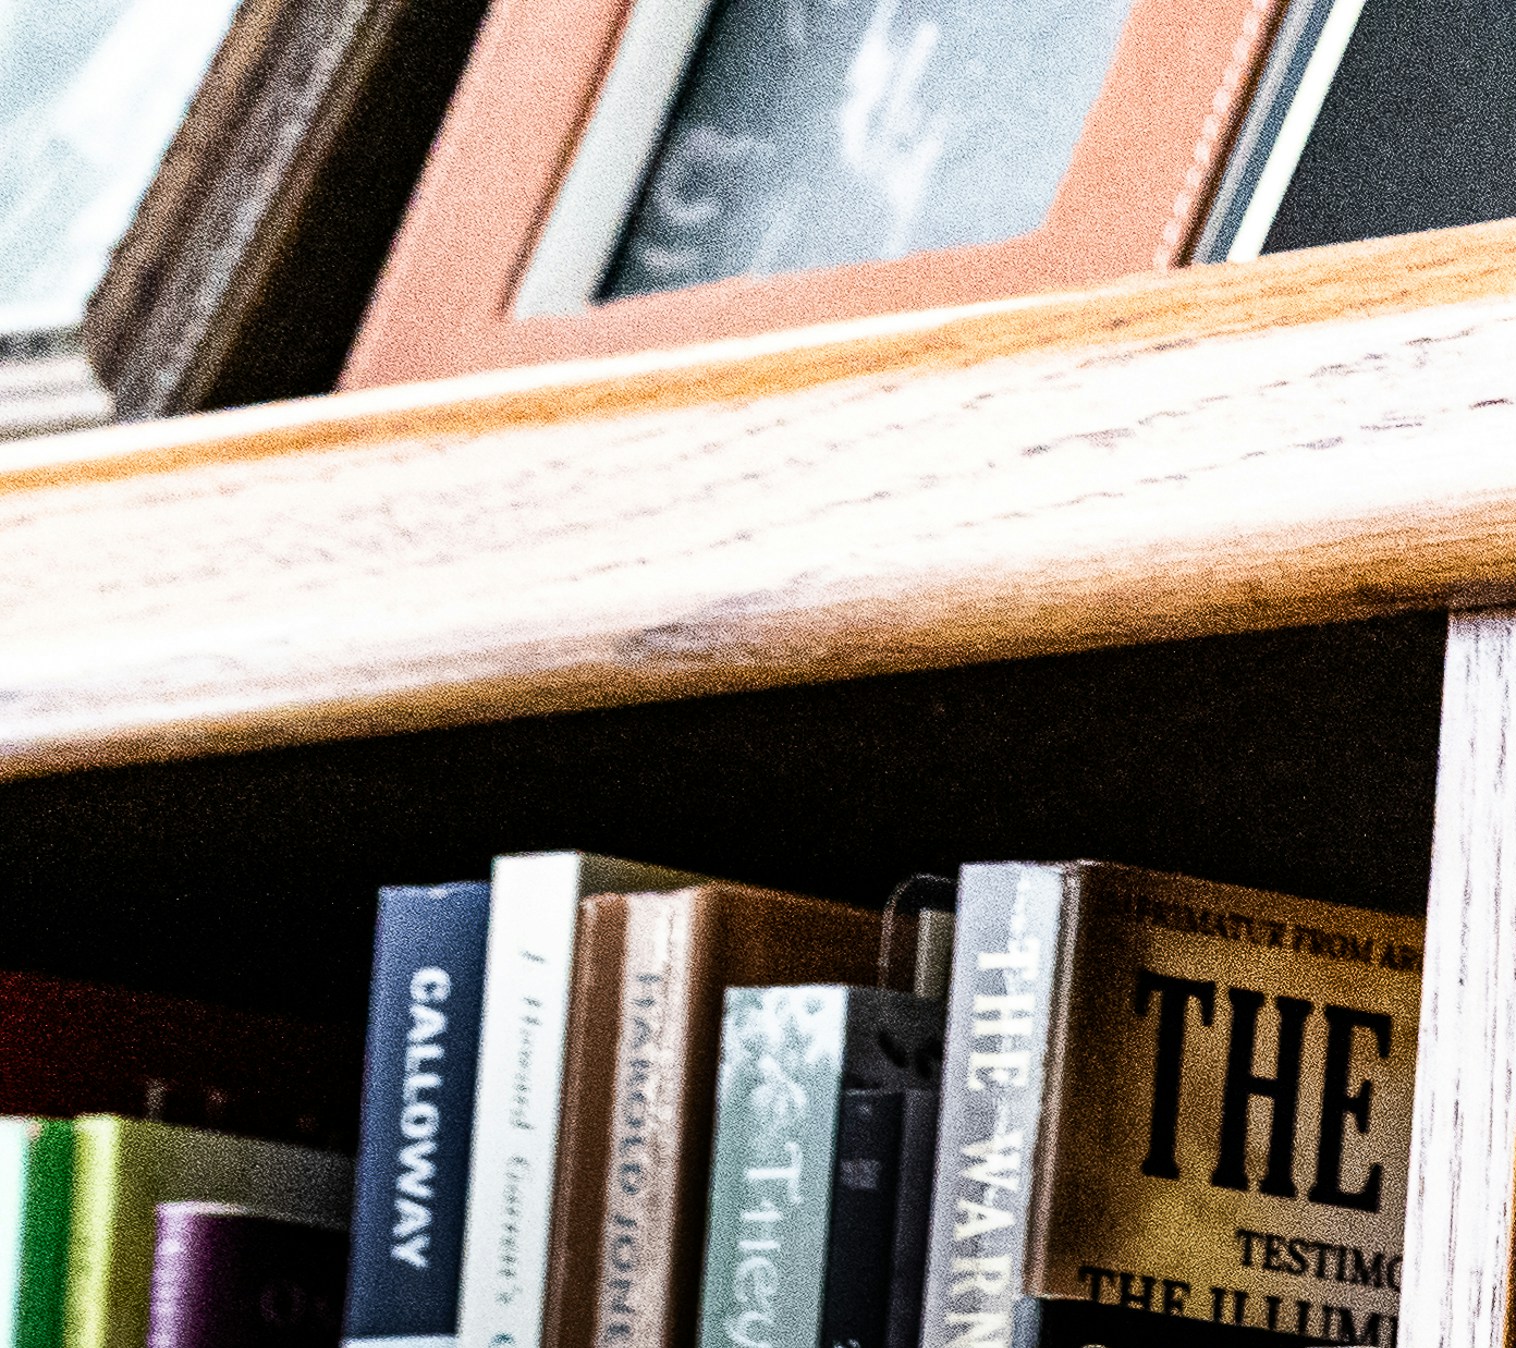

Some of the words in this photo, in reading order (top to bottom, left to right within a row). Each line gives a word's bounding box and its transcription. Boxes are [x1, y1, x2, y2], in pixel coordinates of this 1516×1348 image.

[387, 966, 453, 1270] CALLOWAY
[617, 972, 663, 1198] HAROLD
[964, 929, 1041, 1095] THE
[1131, 969, 1394, 1214] THE
